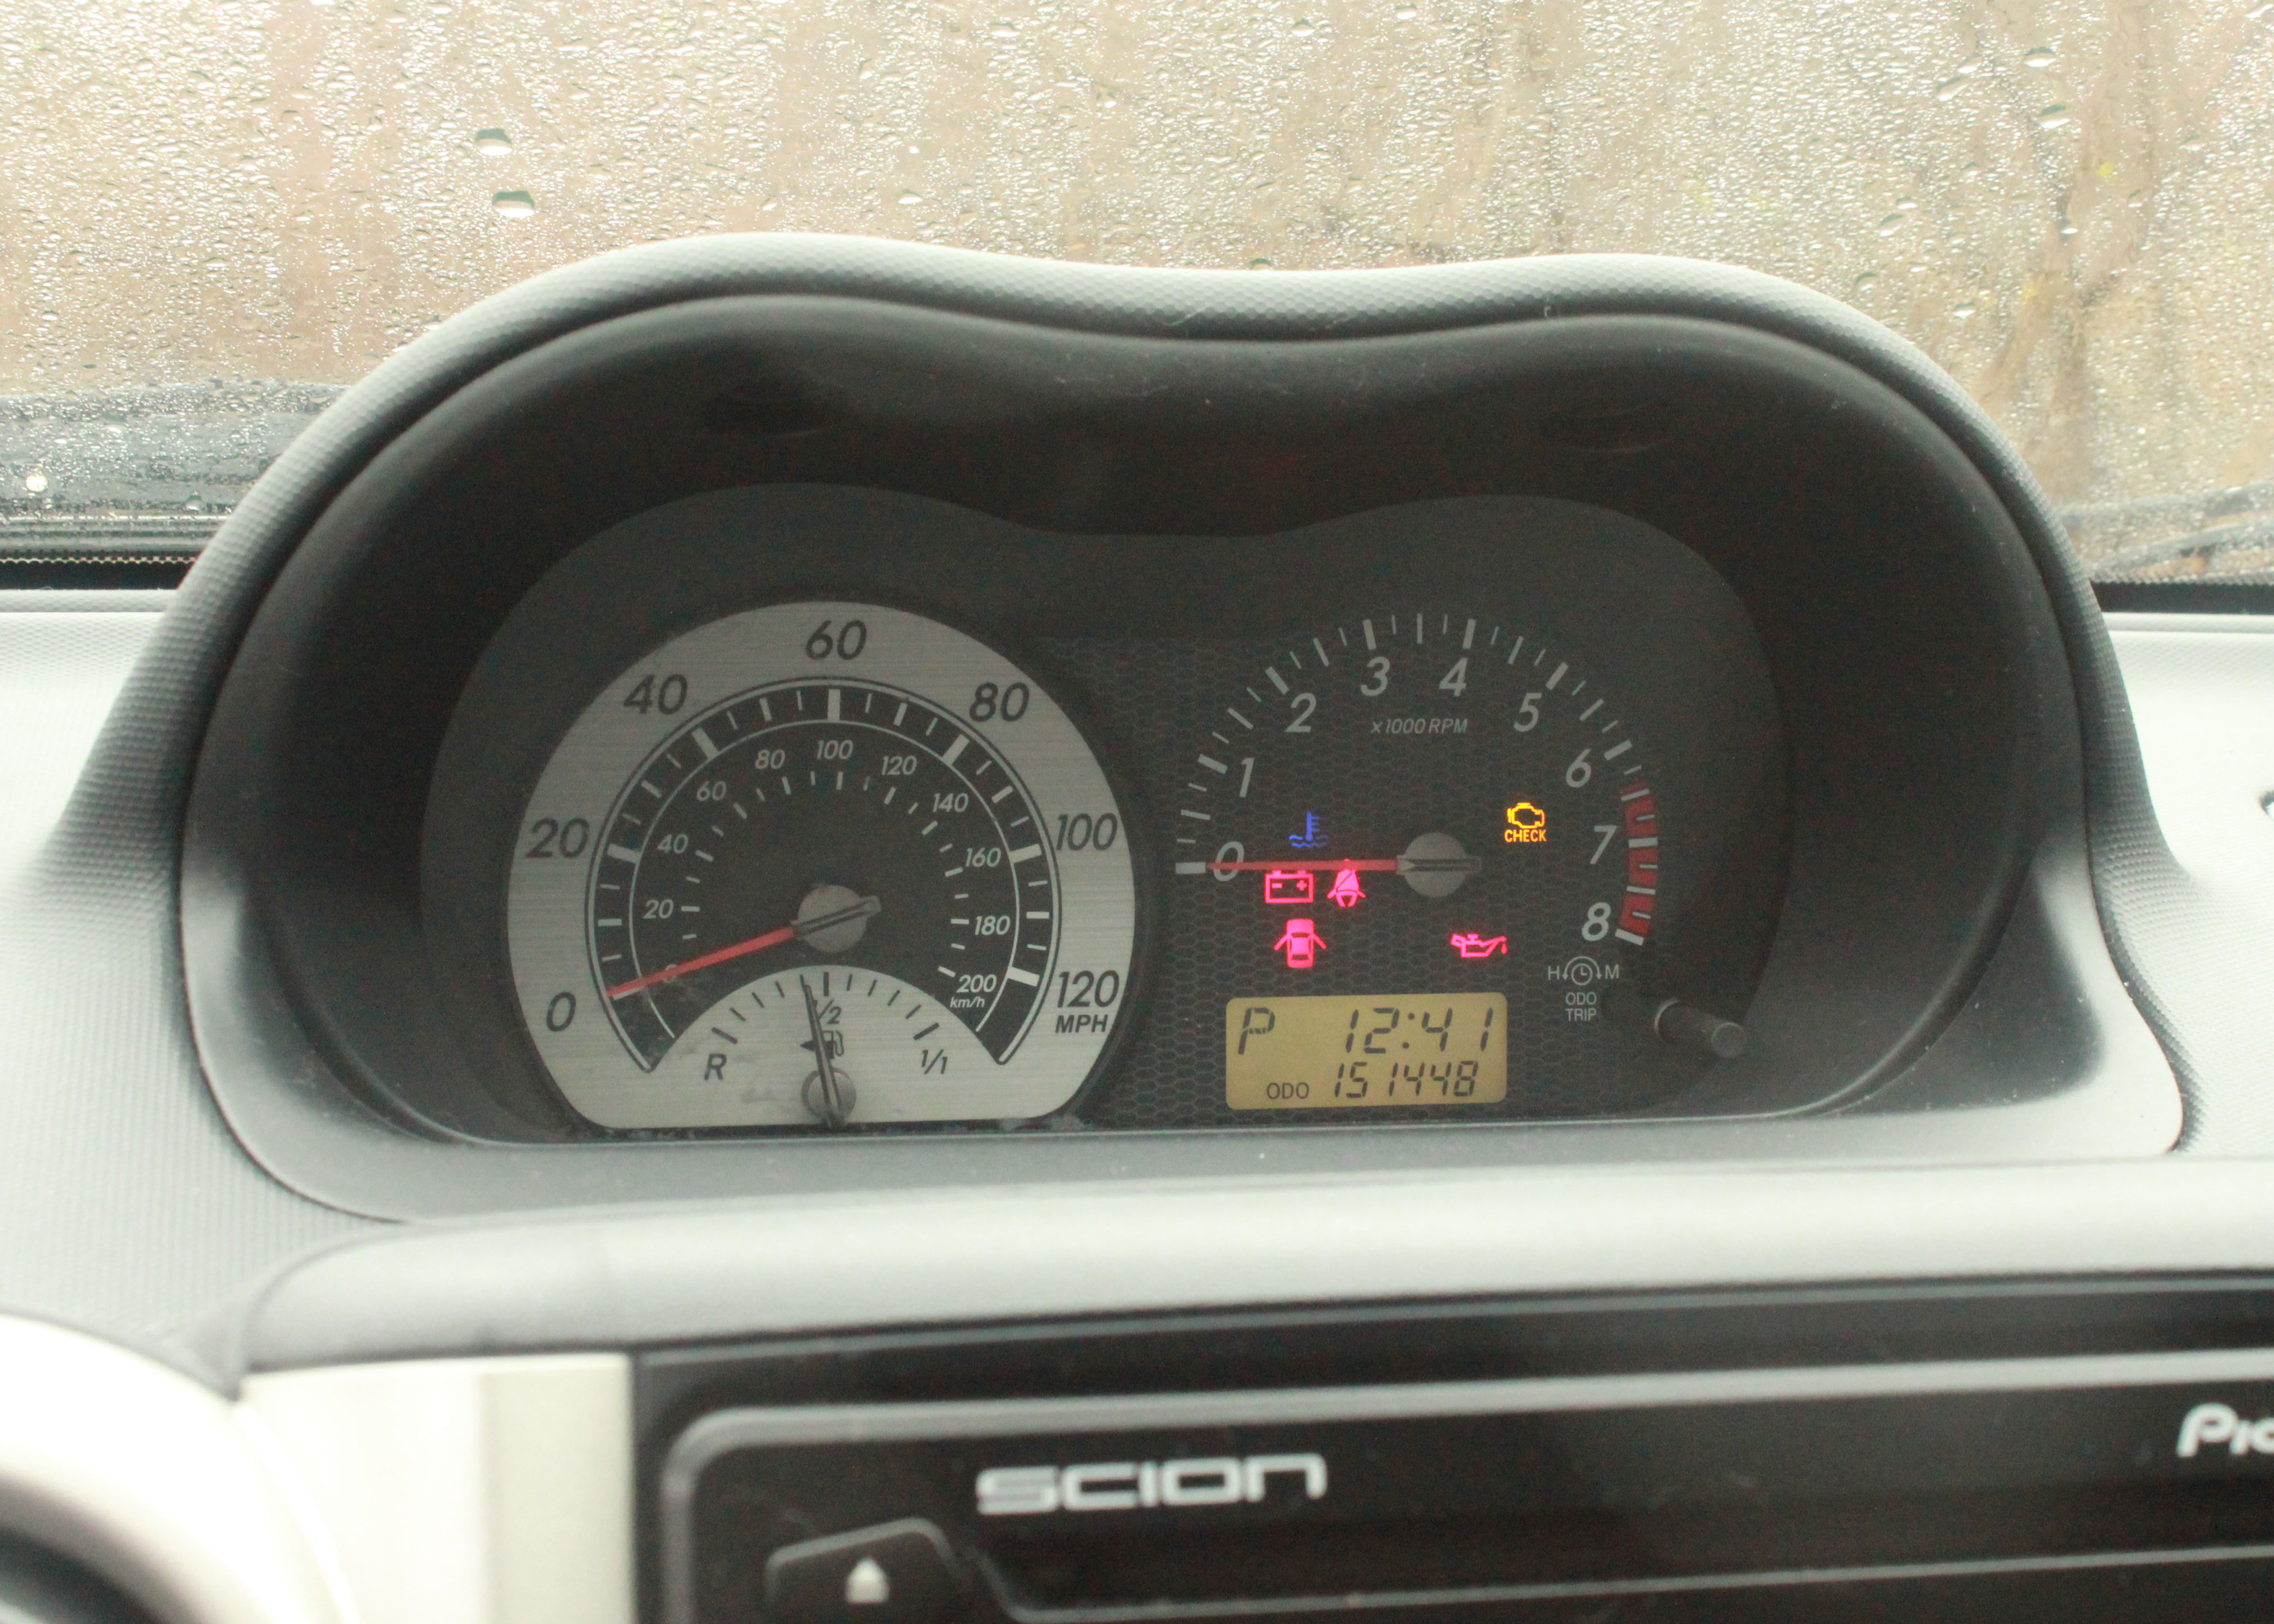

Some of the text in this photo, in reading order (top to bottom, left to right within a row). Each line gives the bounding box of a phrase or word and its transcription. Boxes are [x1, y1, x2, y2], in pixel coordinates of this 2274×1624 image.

[805, 619, 868, 661] 60
[1360, 656, 1391, 697] 3
[1439, 657, 1468, 697] 4
[623, 674, 688, 715] 40
[969, 682, 1030, 722] 80
[1285, 692, 1317, 733] 2
[1428, 717, 1469, 734] RPM
[1513, 692, 1543, 733] 5
[754, 749, 786, 770] 80
[816, 739, 854, 760] 100
[881, 755, 918, 776] 120
[1239, 757, 1255, 798] 1
[1565, 748, 1592, 788] 6
[696, 780, 727, 802] 60
[932, 792, 969, 813] 140
[524, 817, 590, 859] 20
[656, 833, 689, 854] 40
[1055, 812, 1119, 851] 100
[1503, 827, 1547, 843] CHECK
[1589, 824, 1618, 865] 7
[965, 847, 1002, 868] 160
[643, 898, 675, 920] 20
[1581, 902, 1611, 942] 8
[974, 915, 1011, 936] 180
[956, 974, 998, 994] 200
[1547, 964, 1620, 980] H M
[949, 996, 986, 1009] km/h
[1057, 970, 1120, 1008] 120
[1564, 991, 1597, 1006] ODO
[545, 990, 577, 1033] 0
[1055, 1014, 1109, 1034] MPH
[1565, 1007, 1597, 1021] TRIP
[1237, 1007, 1494, 1056] P 12:41
[703, 1052, 728, 1081] R
[921, 1048, 948, 1075] 1/1
[1265, 1060, 1479, 1101] ODO 151448
